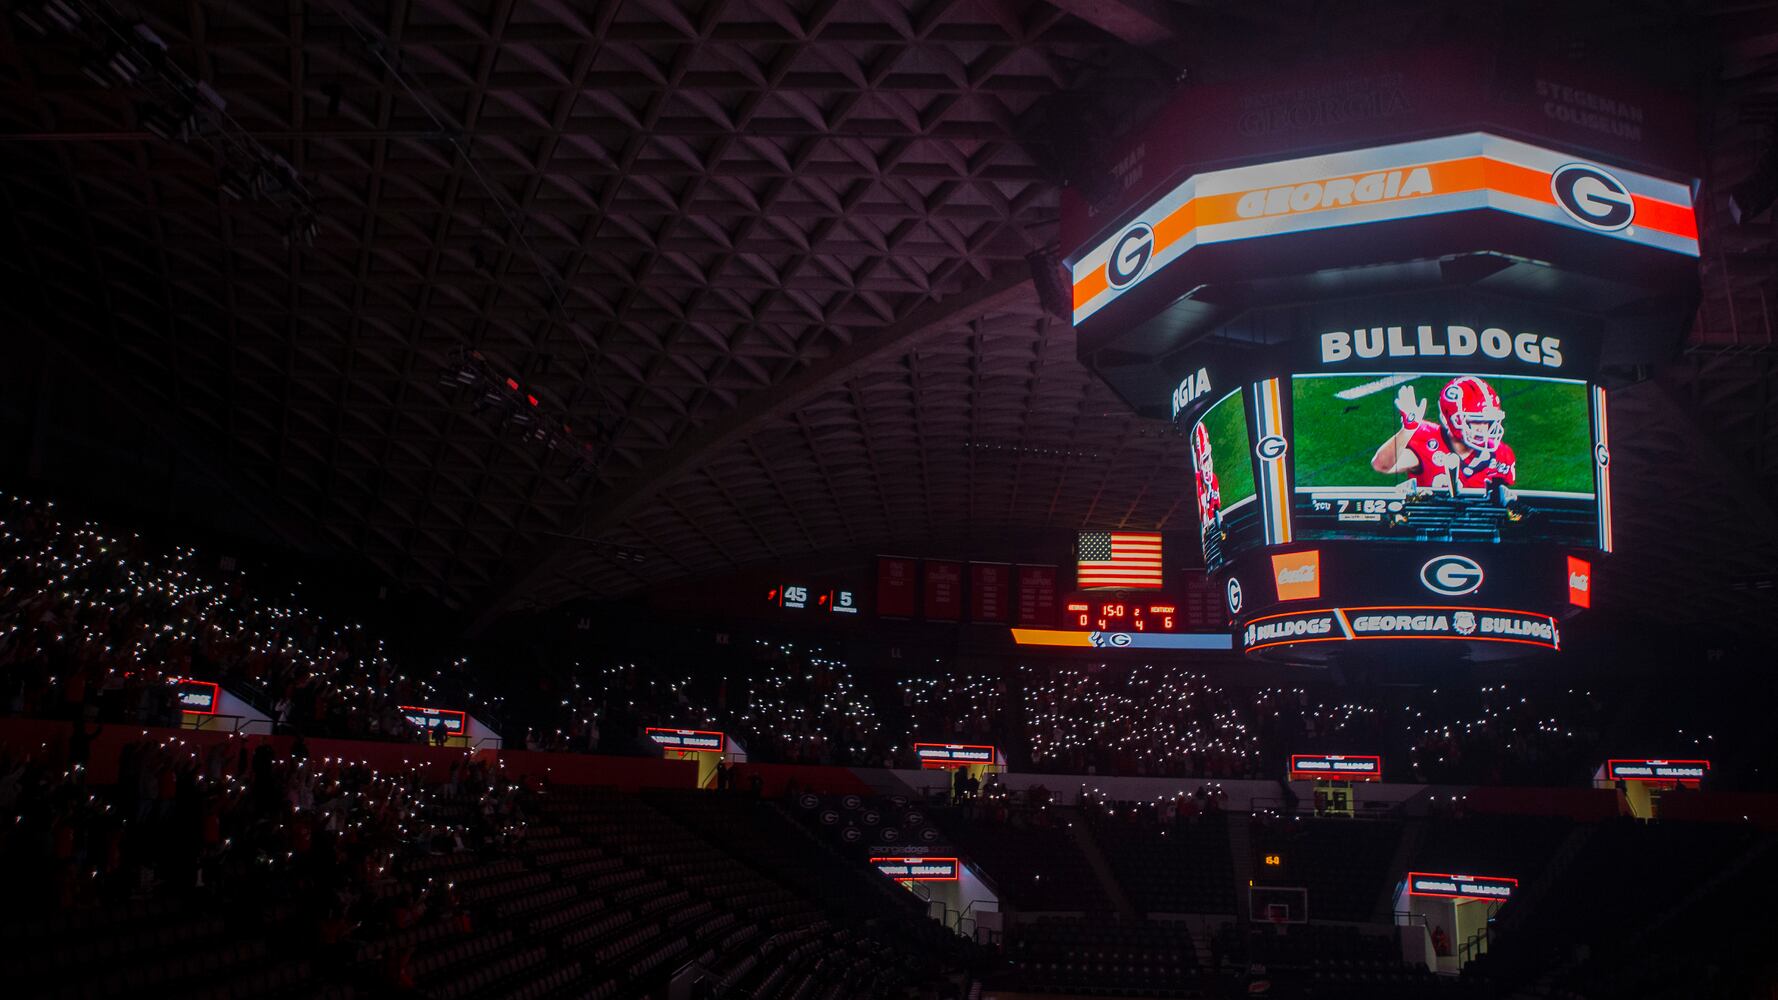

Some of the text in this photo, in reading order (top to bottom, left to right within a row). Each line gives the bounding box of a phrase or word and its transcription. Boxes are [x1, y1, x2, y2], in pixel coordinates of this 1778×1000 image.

[1236, 167, 1433, 218] GEORGIA
[1552, 164, 1634, 230] G
[1107, 224, 1153, 288] G
[1321, 326, 1563, 368] BULLDOGS
[1337, 500, 1349, 513] 7
[1364, 500, 1386, 513] 52
[1421, 557, 1482, 594] G
[784, 586, 807, 602] 45
[840, 591, 852, 606] 5
[1080, 614, 1172, 631] 0 4 4 6
[1257, 618, 1332, 641] BULLDOGS
[1353, 615, 1552, 640] GEORGIA BULLDOGS
